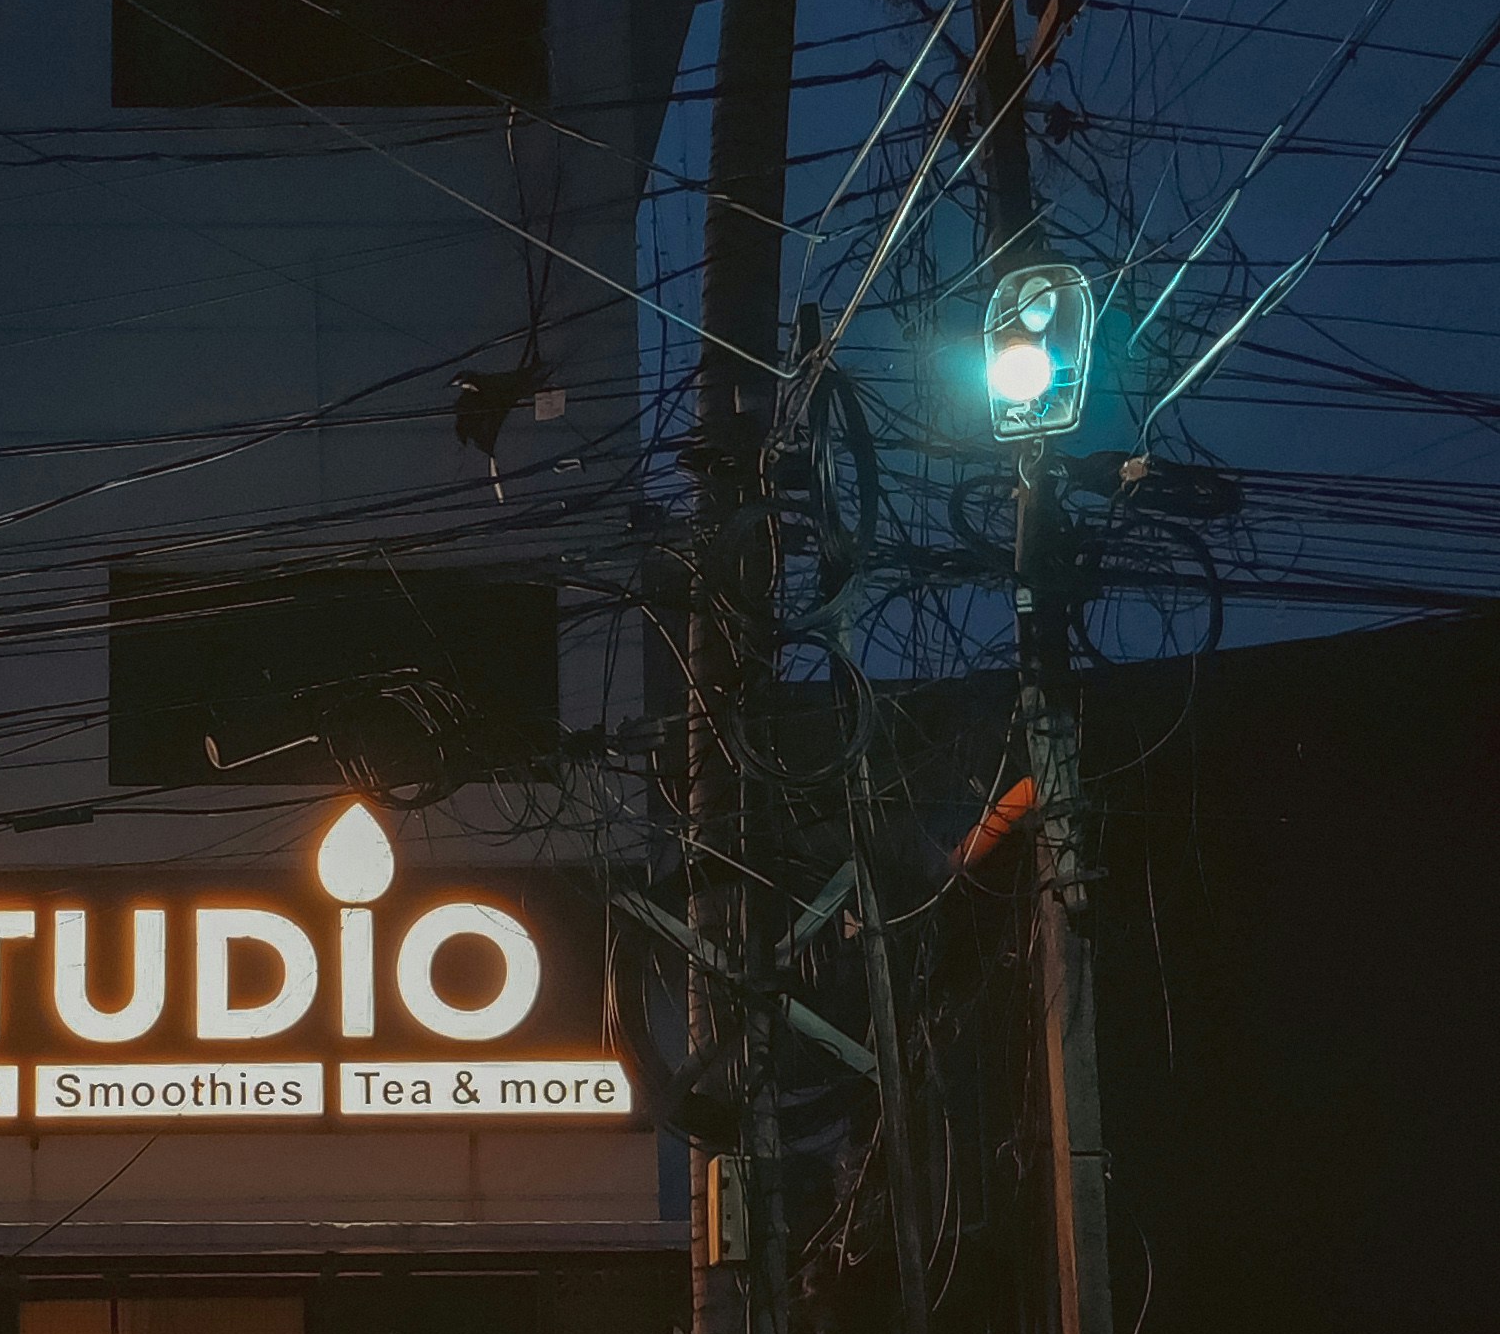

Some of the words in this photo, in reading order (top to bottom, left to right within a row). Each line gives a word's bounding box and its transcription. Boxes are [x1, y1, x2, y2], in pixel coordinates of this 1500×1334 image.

[55, 1071, 304, 1108] Smoothies
[353, 1071, 432, 1106] Tea
[452, 1070, 482, 1105] &
[500, 1078, 616, 1106] more
